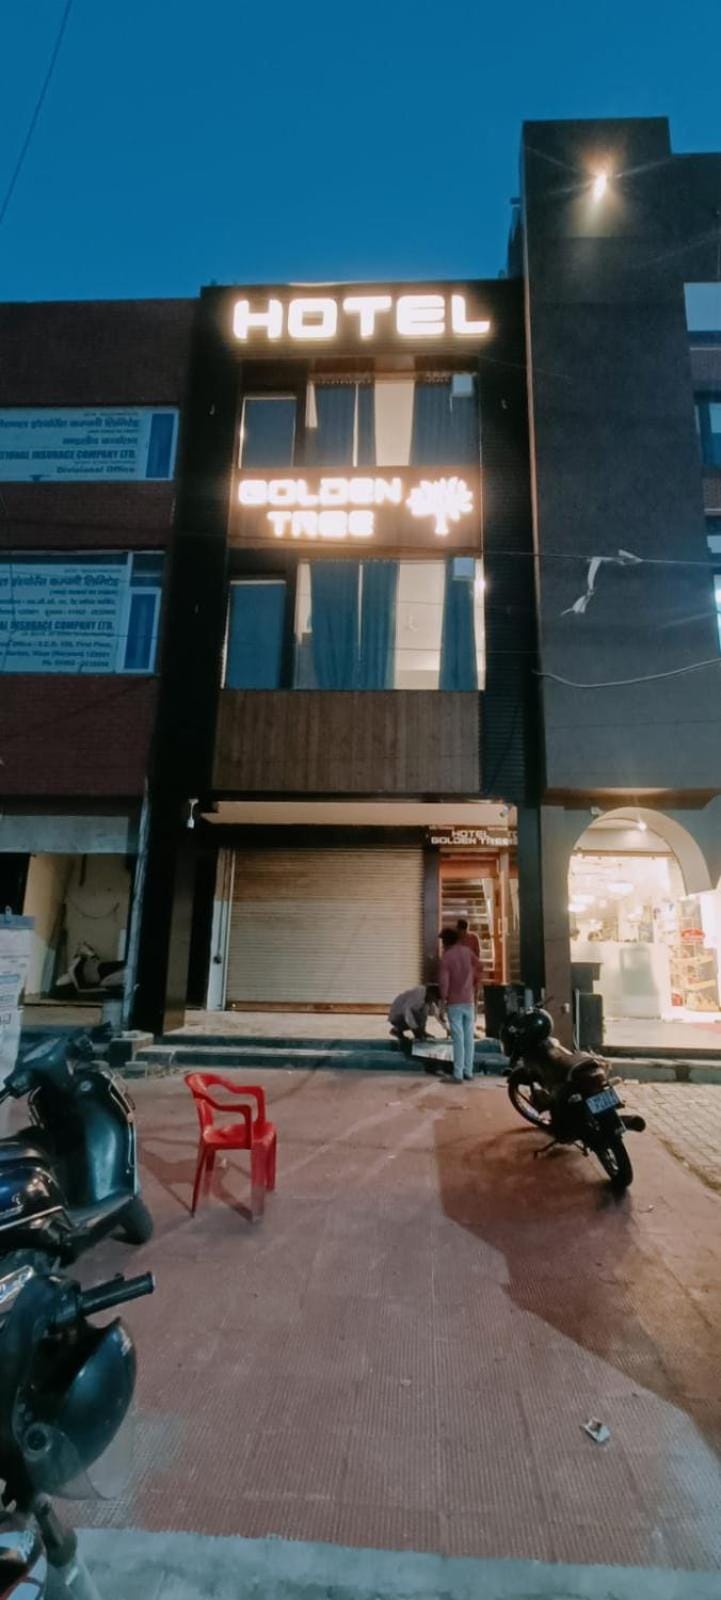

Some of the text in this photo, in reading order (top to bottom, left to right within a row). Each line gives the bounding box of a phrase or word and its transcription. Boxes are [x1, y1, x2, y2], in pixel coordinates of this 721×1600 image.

[233, 295, 490, 340] HOTEL
[77, 450, 118, 459] COMPANY
[106, 465, 136, 473] Office
[238, 478, 402, 505] GOLDEN
[267, 510, 374, 537] TREE
[54, 621, 97, 630] COMPANY
[451, 830, 487, 838] HOTEL
[431, 836, 477, 845] GOLDEN
